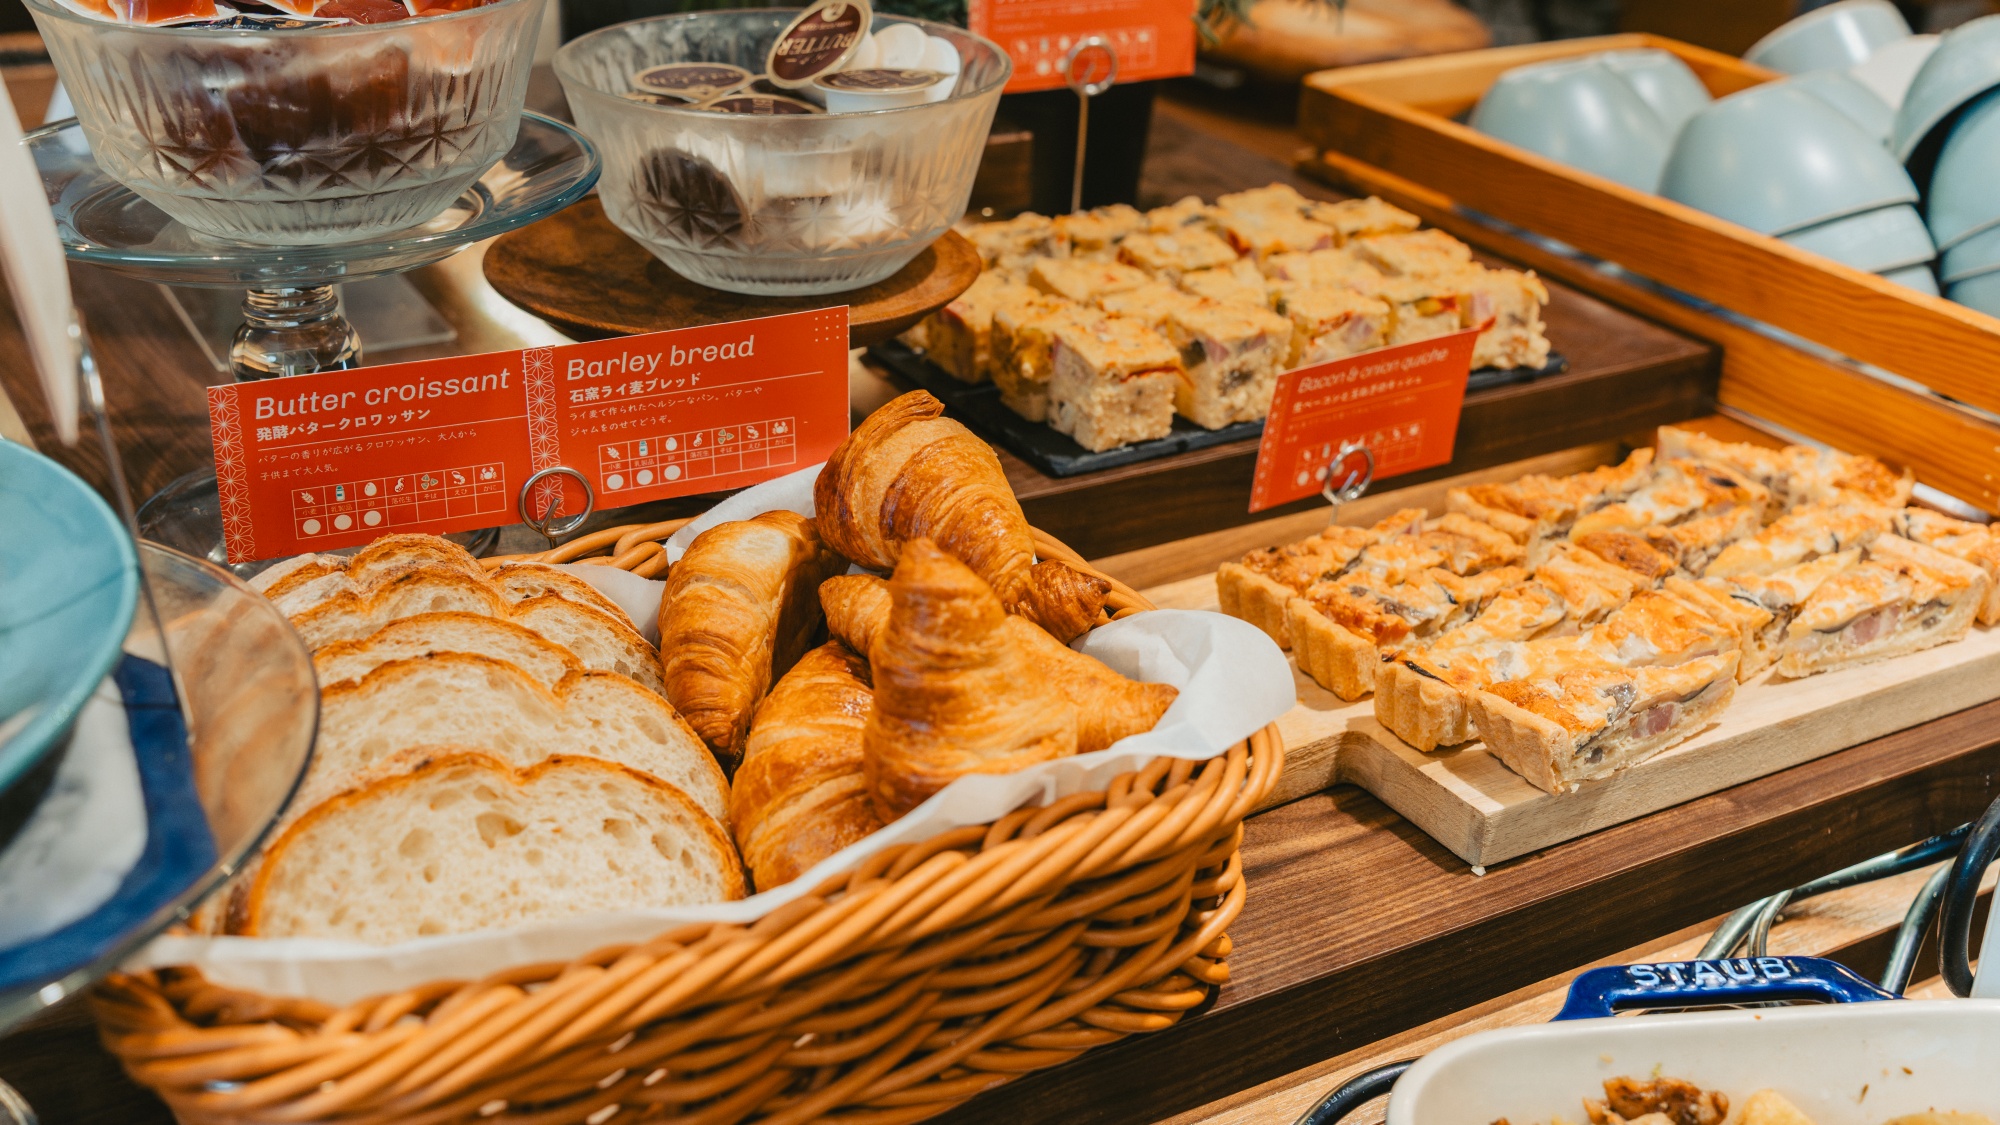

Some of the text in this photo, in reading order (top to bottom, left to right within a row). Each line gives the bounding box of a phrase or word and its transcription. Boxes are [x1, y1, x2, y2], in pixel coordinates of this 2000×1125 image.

[776, 31, 857, 56] BUTTER
[566, 335, 755, 381] Barley bread
[1297, 348, 1449, 394] Bacon & onion quiche
[255, 368, 511, 420] Butter croissant
[569, 372, 701, 403] 石窯ライ麦ブレッド
[256, 408, 431, 442] 発酵バタークロワッサン
[570, 414, 672, 437] ジャムをのせてどうぞ。
[260, 463, 340, 481] 子供まで大人気。
[1629, 957, 1792, 987] STAUB
[1322, 1086, 1354, 1110] WIRE
